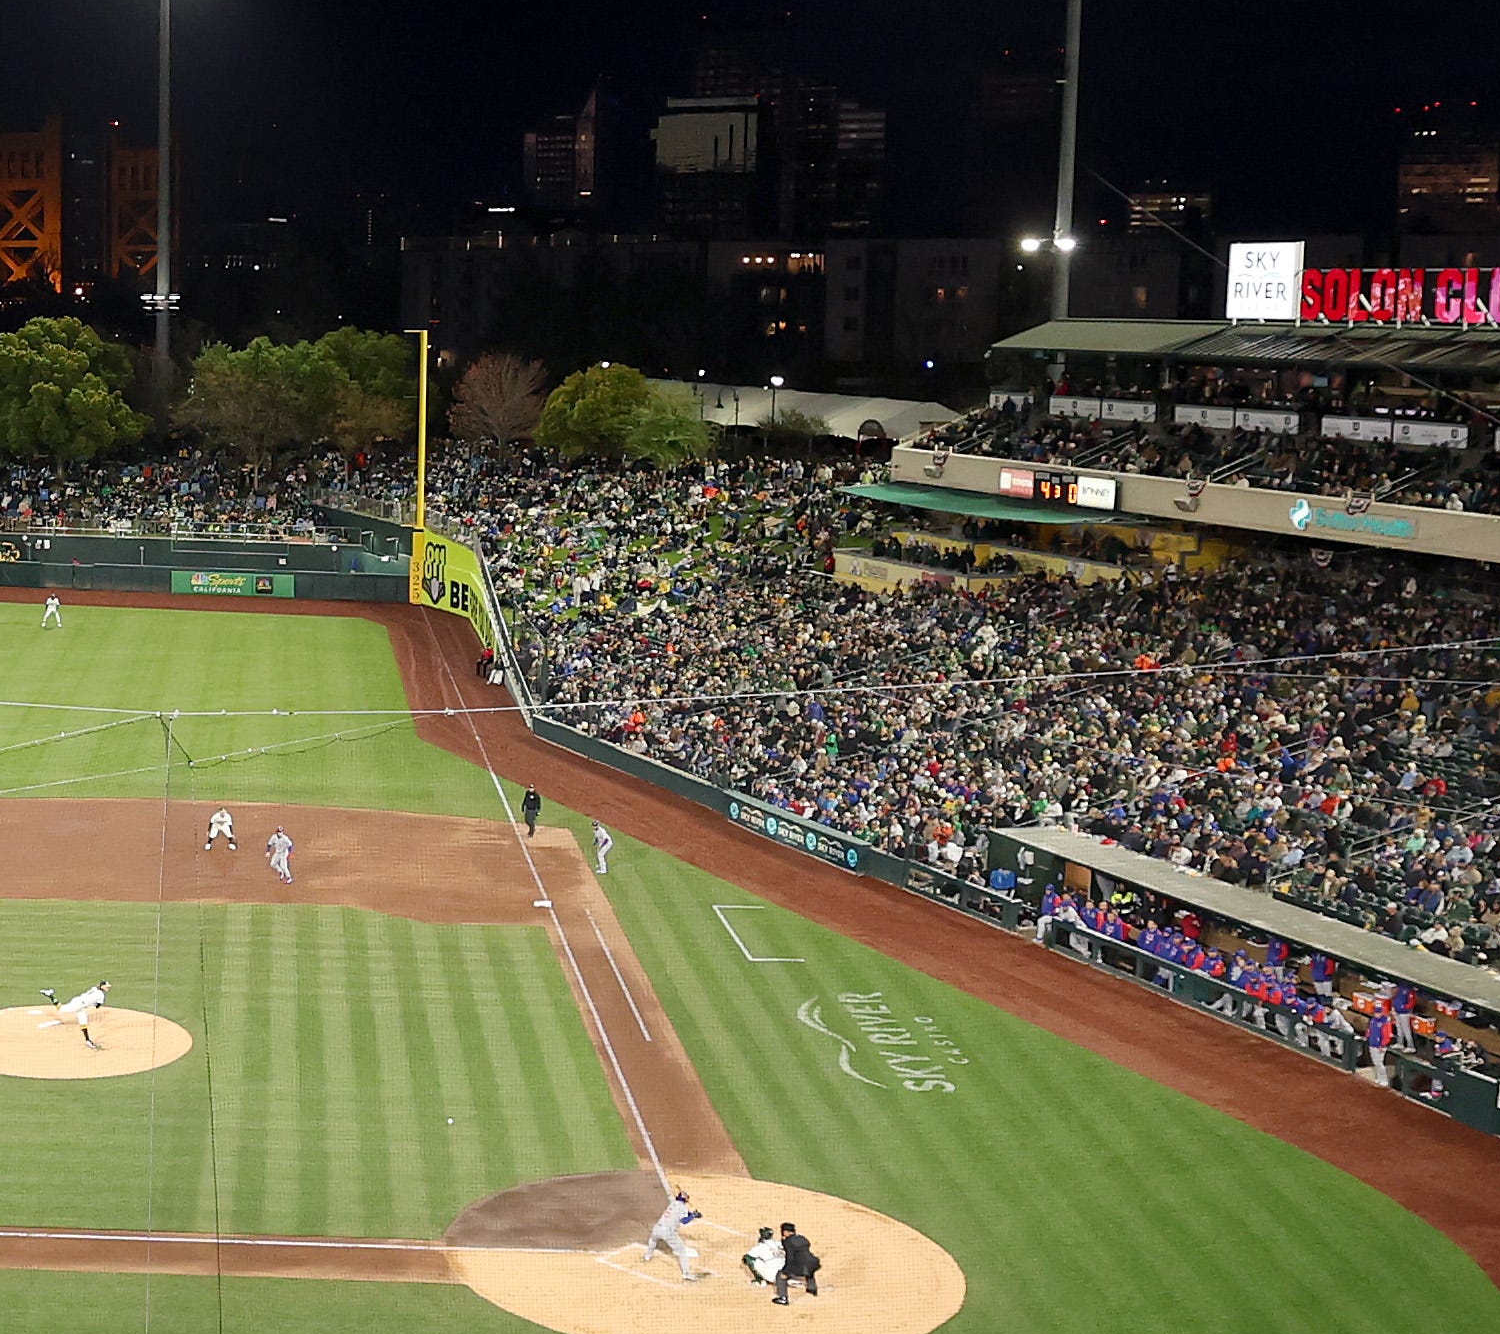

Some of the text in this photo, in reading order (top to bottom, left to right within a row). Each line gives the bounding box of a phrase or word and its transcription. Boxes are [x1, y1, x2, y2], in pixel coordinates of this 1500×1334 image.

[1245, 251, 1281, 270] SKY
[1234, 282, 1287, 300] RIVER
[1302, 268, 1425, 322] SOLON
[1041, 482, 1050, 499] 4
[1068, 484, 1077, 504] 0
[208, 574, 247, 587] Sports
[838, 992, 956, 1092] SKY RIVER
[914, 1017, 969, 1064] CASINO
